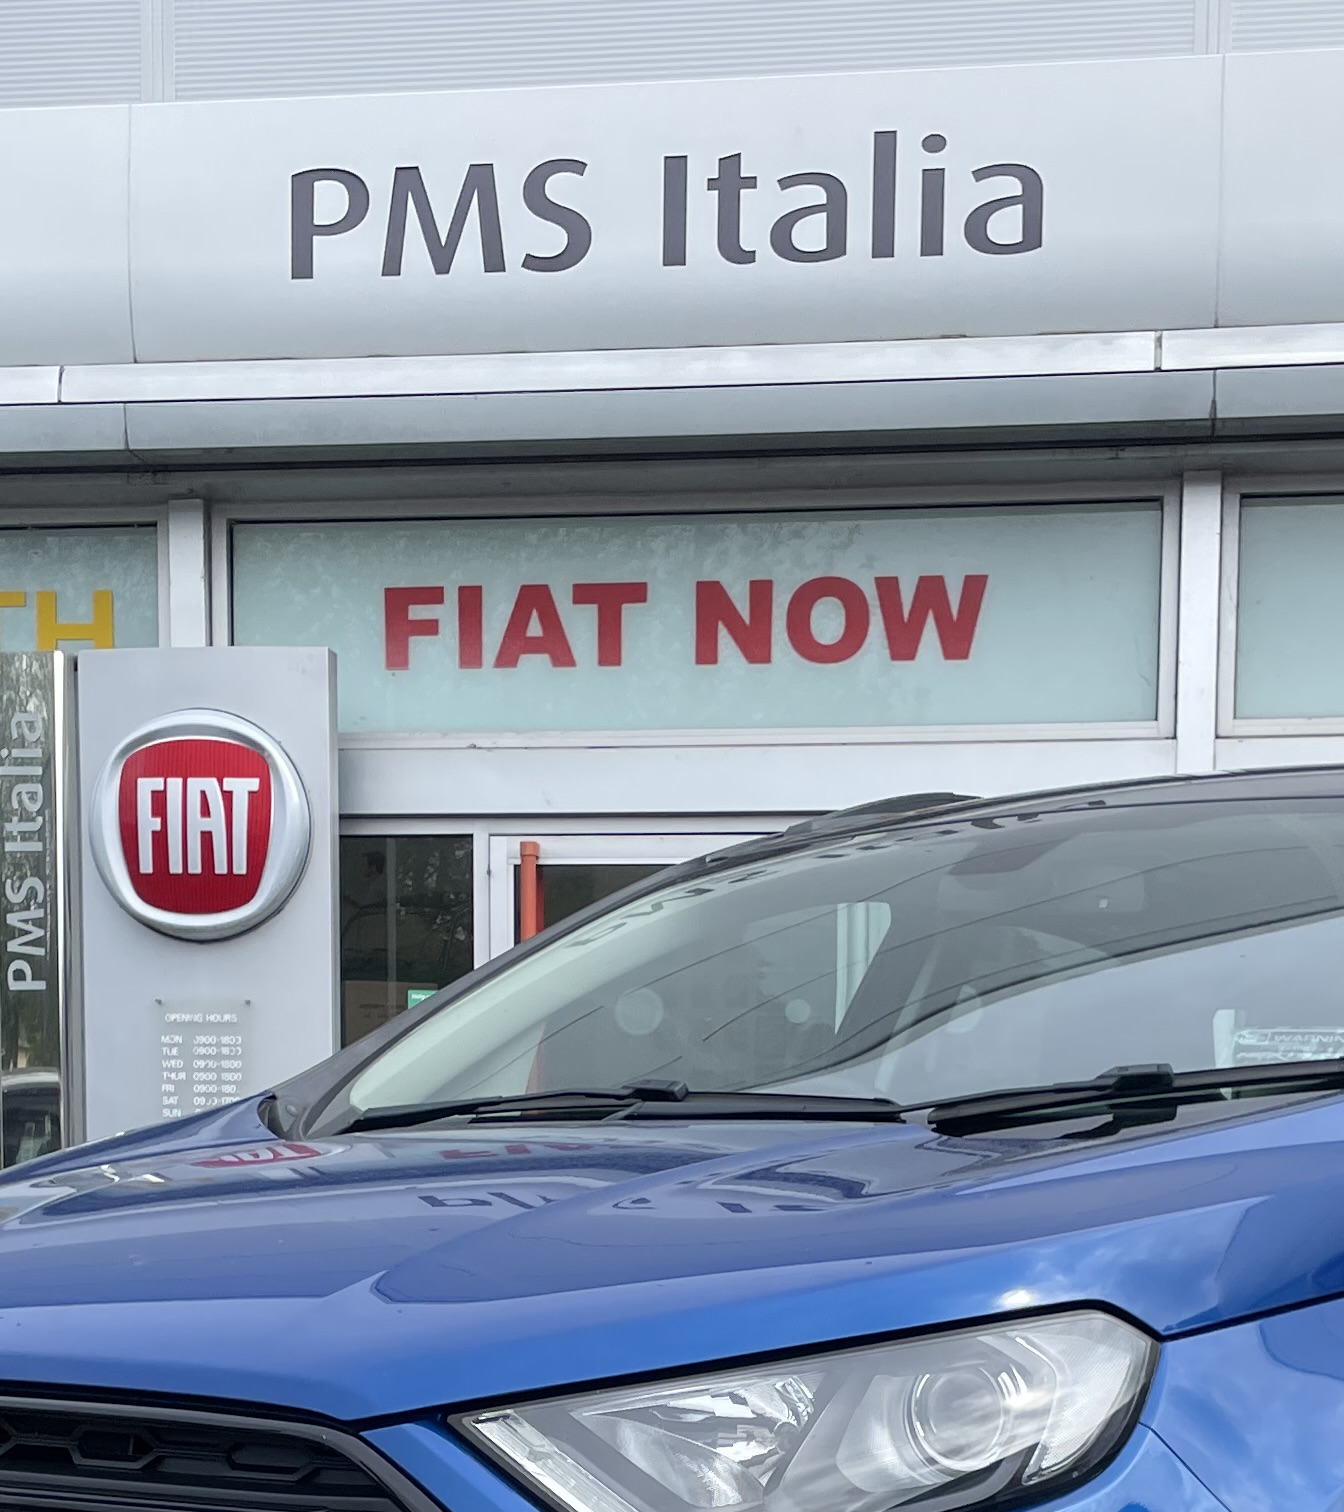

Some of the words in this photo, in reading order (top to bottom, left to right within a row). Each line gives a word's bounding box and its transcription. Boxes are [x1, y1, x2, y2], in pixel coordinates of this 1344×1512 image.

[290, 158, 592, 280] PMS
[662, 130, 1044, 266] Italia
[383, 581, 648, 671] FIAT
[694, 574, 989, 666] NOW
[0, 712, 44, 852] Italia
[136, 777, 260, 876] FIAT
[6, 876, 47, 991] PMS
[164, 1012, 203, 1023] OPENING
[205, 1012, 238, 1023] HOURS
[160, 1034, 183, 1044] MON
[161, 1046, 179, 1056] TUE
[161, 1059, 184, 1069] WED
[161, 1084, 175, 1093] FRI
[162, 1096, 179, 1106] SAT
[161, 1108, 182, 1118] SUN
